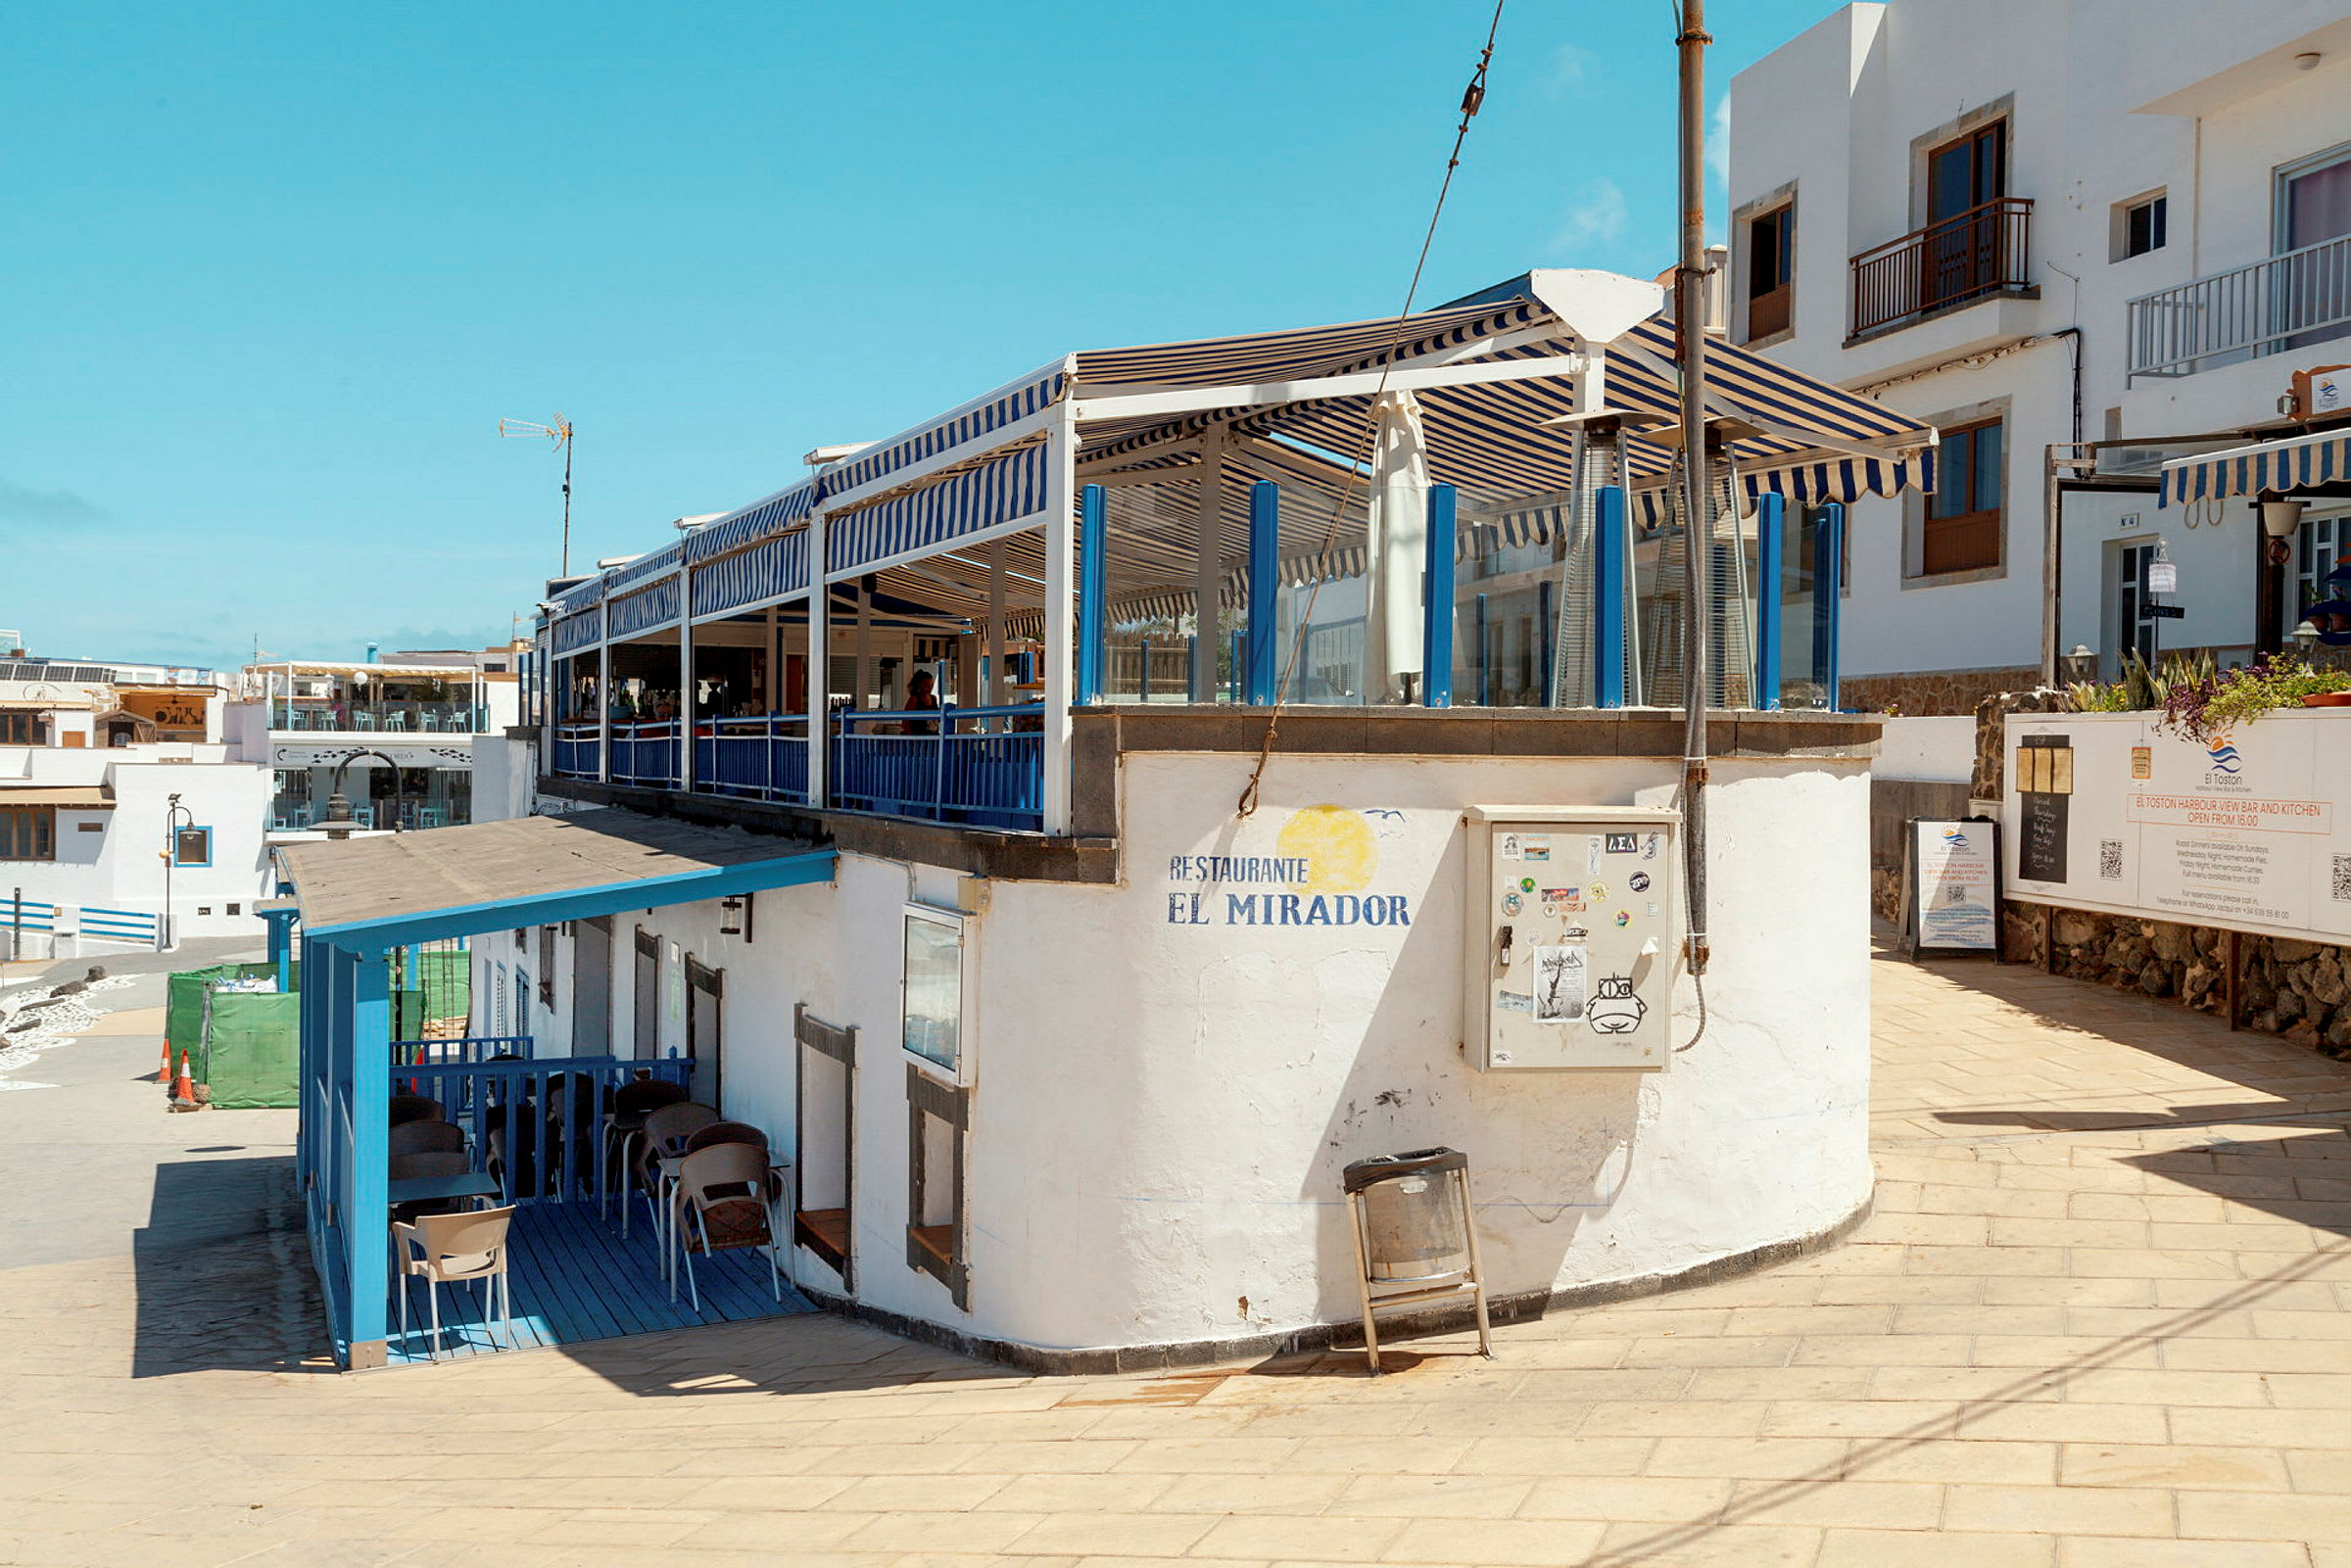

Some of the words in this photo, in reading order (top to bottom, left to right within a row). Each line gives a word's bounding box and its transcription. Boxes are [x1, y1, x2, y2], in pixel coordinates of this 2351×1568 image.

[2205, 773, 2212, 784] El
[2214, 774, 2243, 785] Toston
[2136, 797, 2145, 808] EL
[2146, 797, 2177, 809] TOSTON
[2179, 799, 2217, 811] HARBOUR
[2218, 800, 2239, 813] VIEW
[2241, 801, 2259, 814] BAR
[2261, 802, 2279, 815] AND
[2281, 803, 2321, 817] KITCHEN
[2187, 811, 2211, 824] OPEN
[2212, 813, 2235, 826] FROM
[2237, 814, 2259, 827] 16.00
[1170, 855, 1309, 883] RESTAURANTE
[1168, 892, 1210, 925] EL
[1225, 893, 1411, 926] MIRADOR
